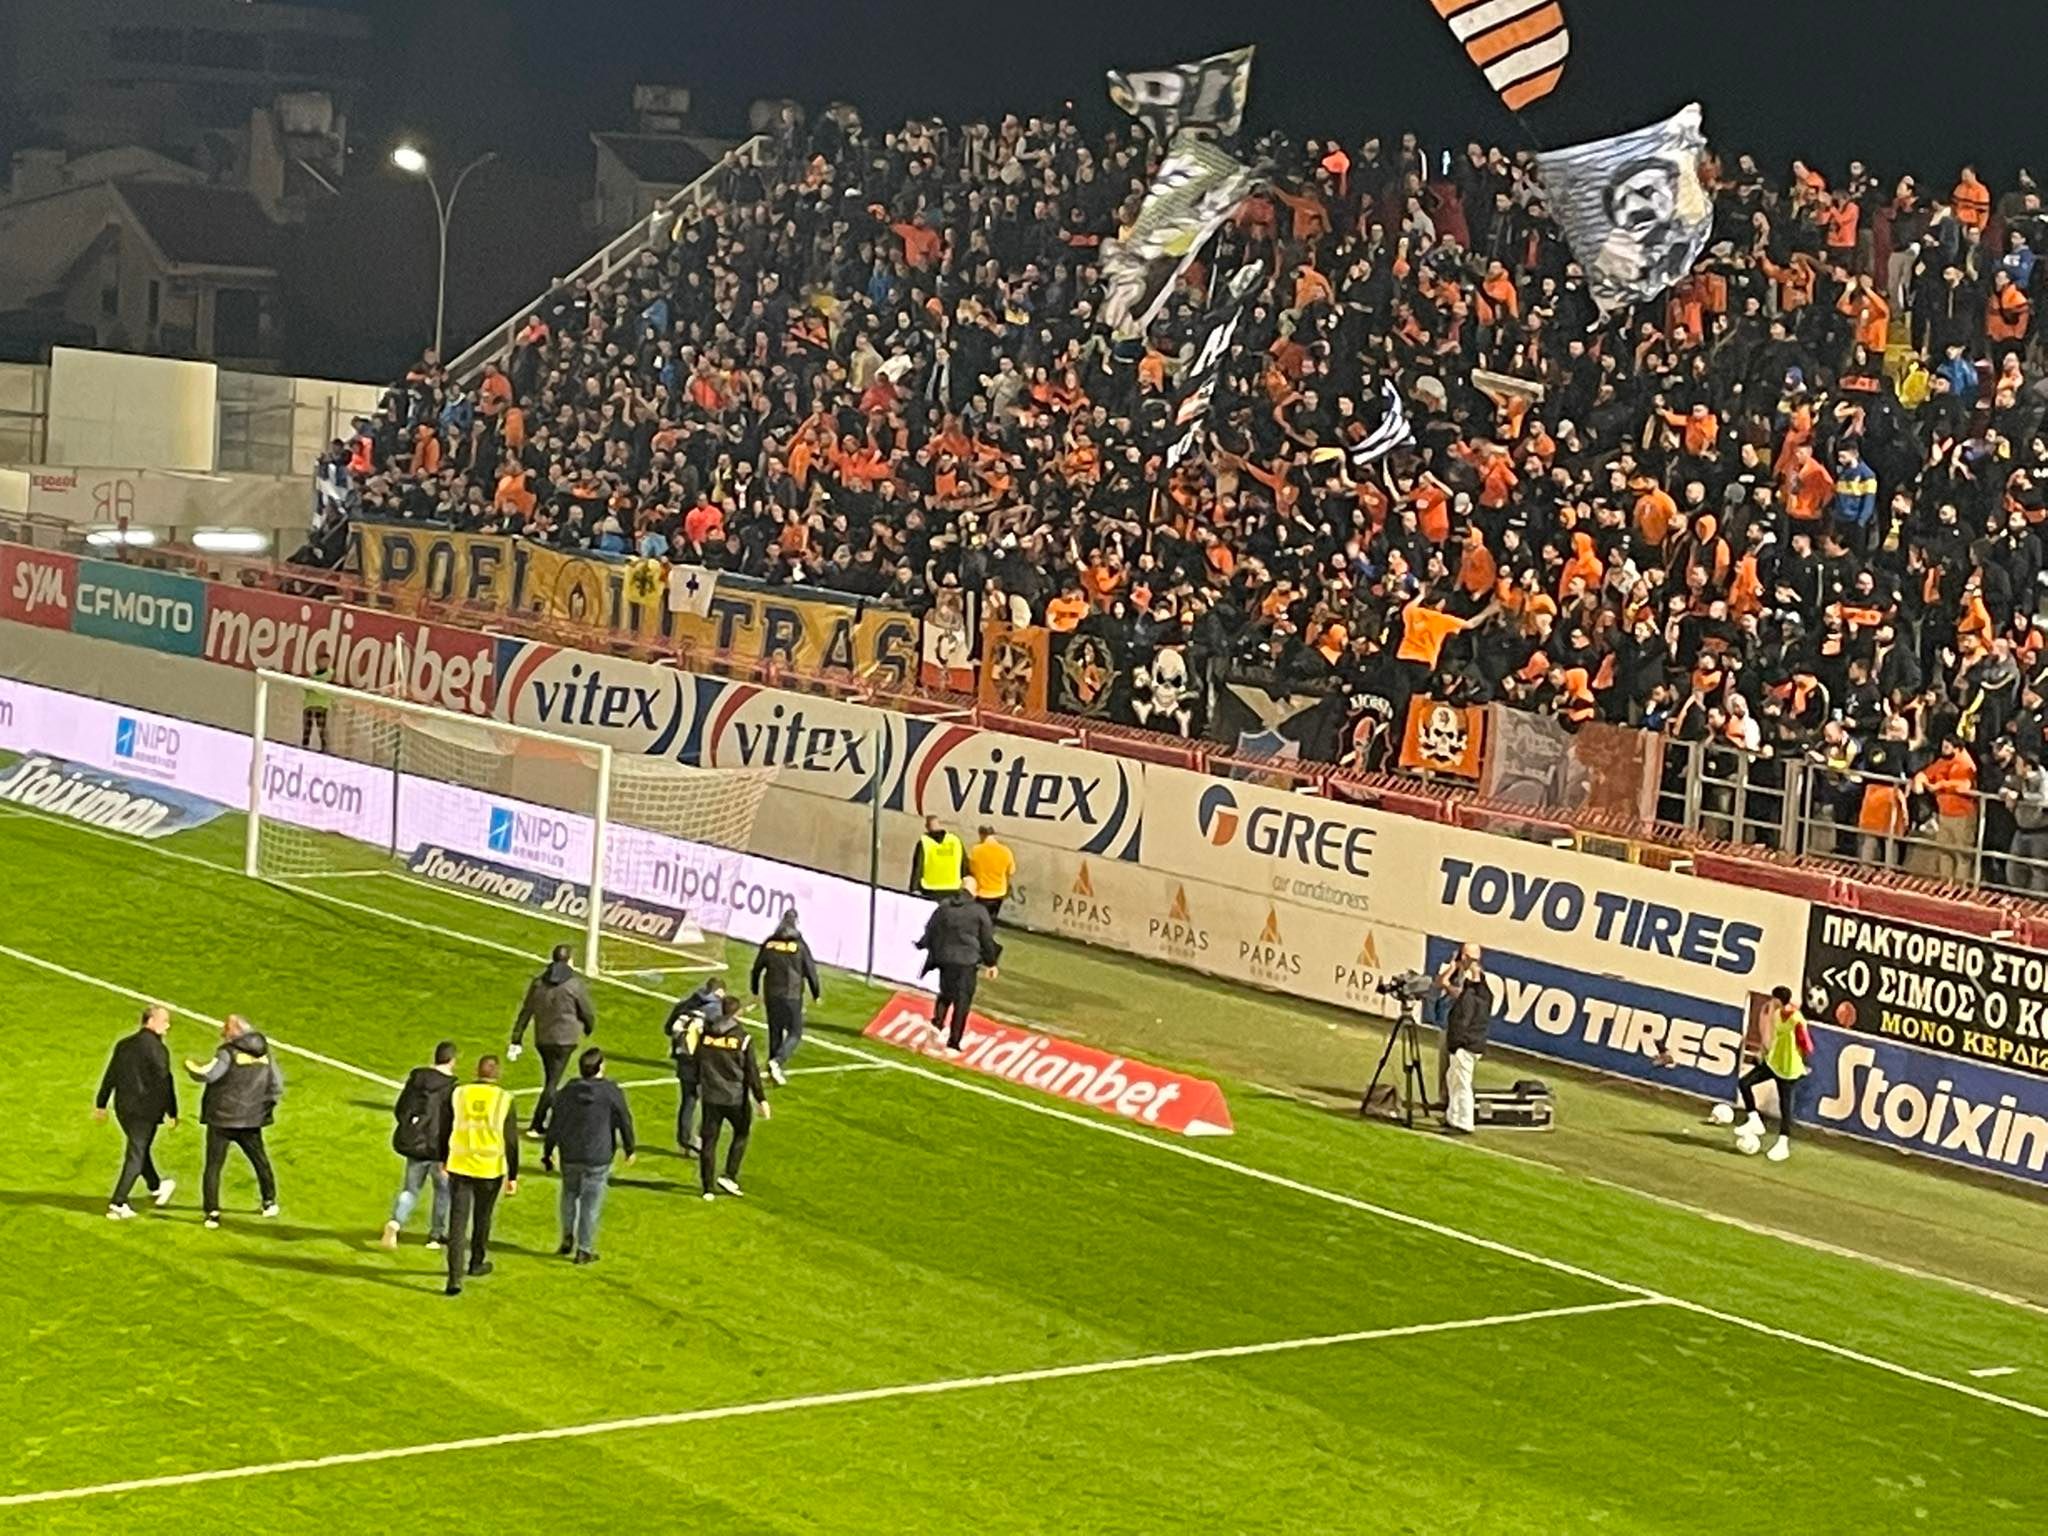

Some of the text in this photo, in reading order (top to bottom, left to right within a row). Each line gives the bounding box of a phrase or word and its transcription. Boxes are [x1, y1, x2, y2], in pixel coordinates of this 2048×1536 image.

[12, 561, 68, 612] SYM
[76, 583, 193, 633] CFMOTO
[205, 604, 493, 715] meridianbet
[532, 663, 661, 731] vitex
[136, 722, 181, 756] NIPD
[734, 704, 870, 775] vitex
[252, 754, 363, 815] ipd.com
[944, 748, 1103, 826] vitex
[515, 812, 569, 851] NIPD
[1246, 806, 1377, 878] GREE
[413, 848, 535, 903] Stoiximan
[652, 852, 798, 919] nipd.com
[1053, 894, 1112, 926] PAPAS
[1149, 918, 1209, 950] PAPAS
[1440, 857, 1764, 975] TOYO TIRES
[1239, 940, 1301, 975] PAPAS
[1822, 914, 1984, 978] ΠΡΑΚΤΟΡΕΙΟ
[1876, 966, 1976, 1023] ΣΙΜΟΣ
[1582, 997, 1744, 1077] TIRES
[1880, 1010, 1955, 1047] ΜΟΝΟ
